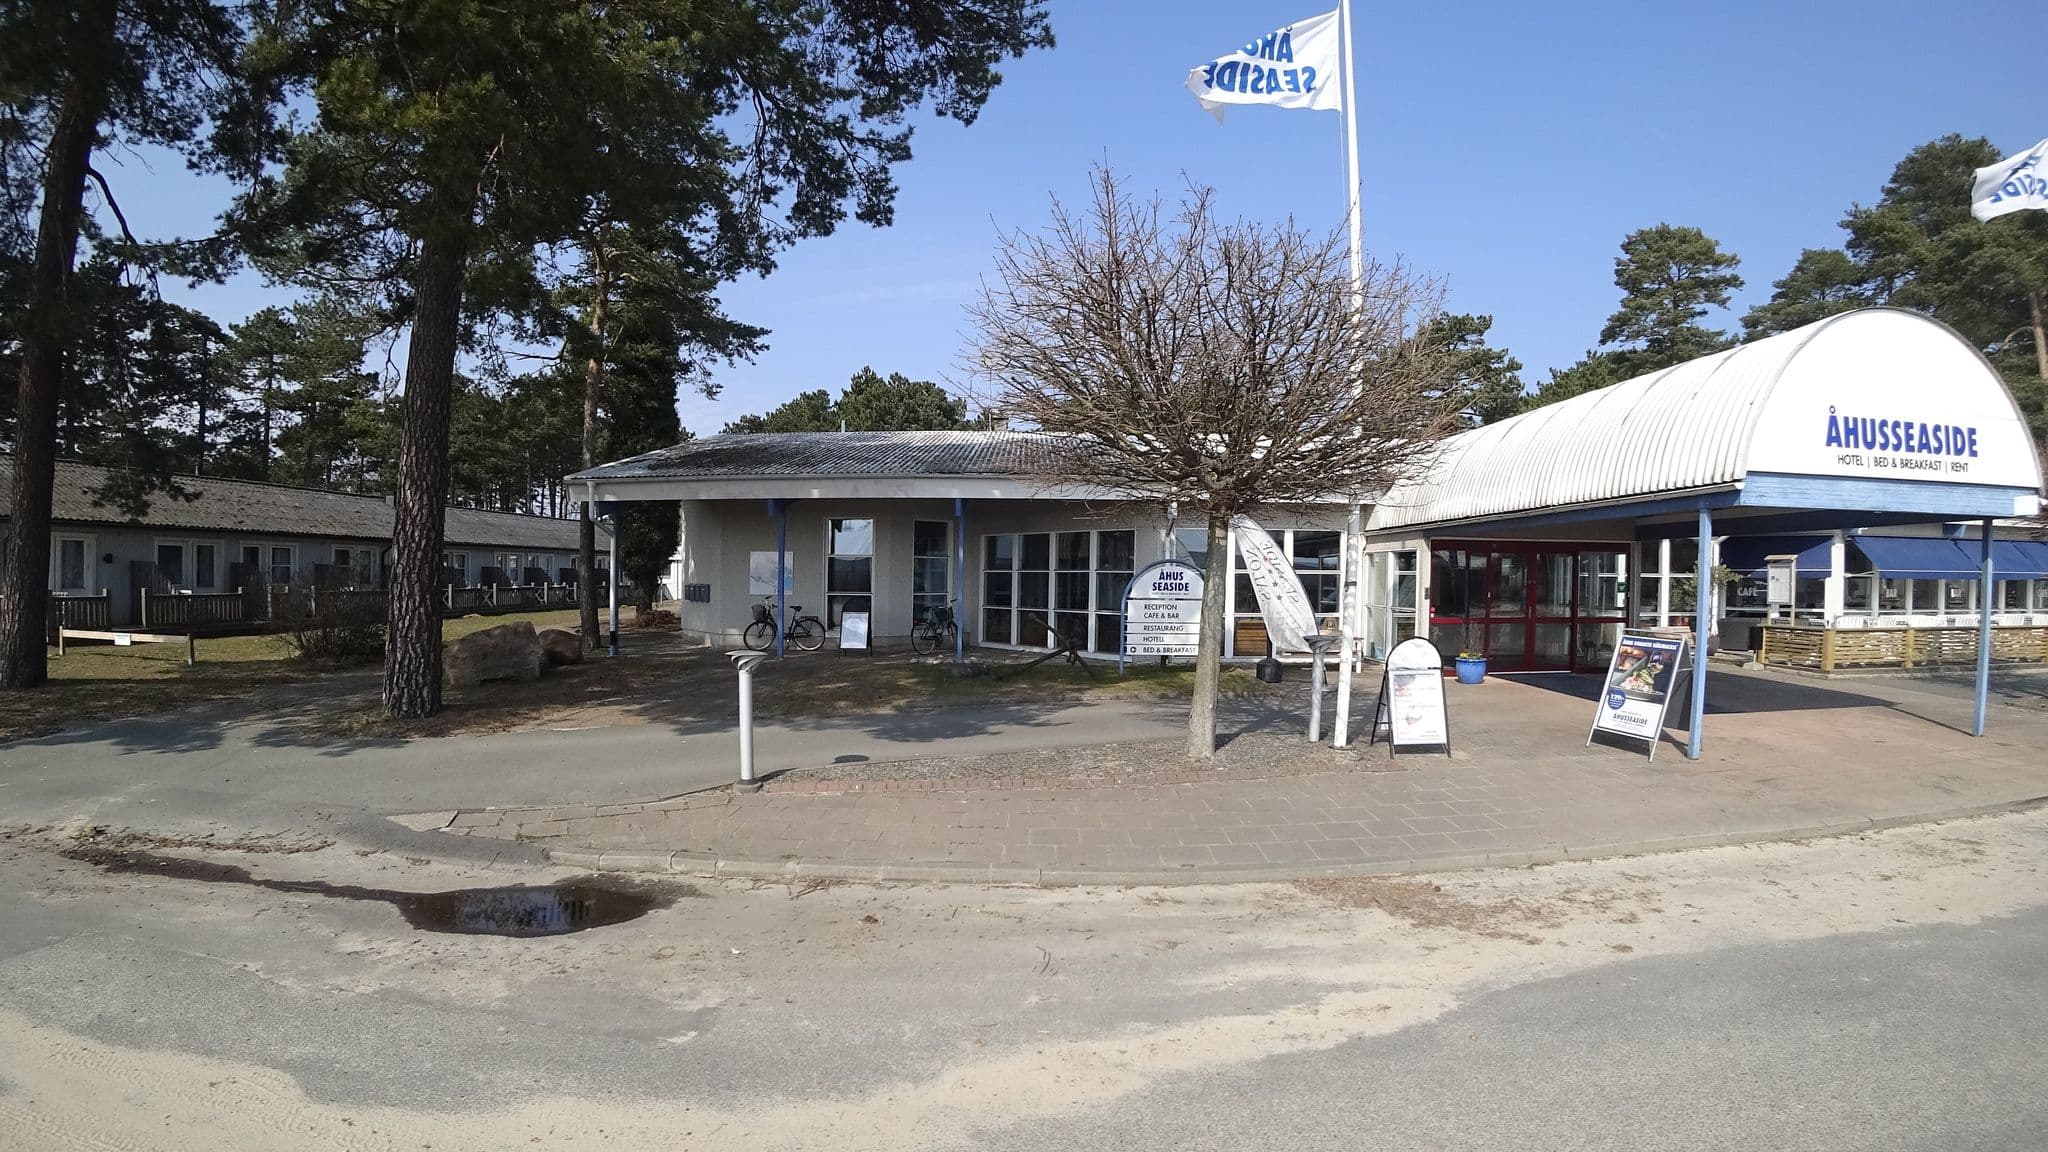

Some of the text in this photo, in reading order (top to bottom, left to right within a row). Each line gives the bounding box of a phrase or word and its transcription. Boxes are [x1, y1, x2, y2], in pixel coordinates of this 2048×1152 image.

[1825, 405, 1978, 458] ÅHUSSEASIDE
[1837, 454, 1969, 473] HOTEL BED & BREAKFAST RENT
[1159, 568, 1184, 581] ÅHUS
[1152, 582, 1190, 592] SEASIDE
[1143, 603, 1178, 611] RECEPTION
